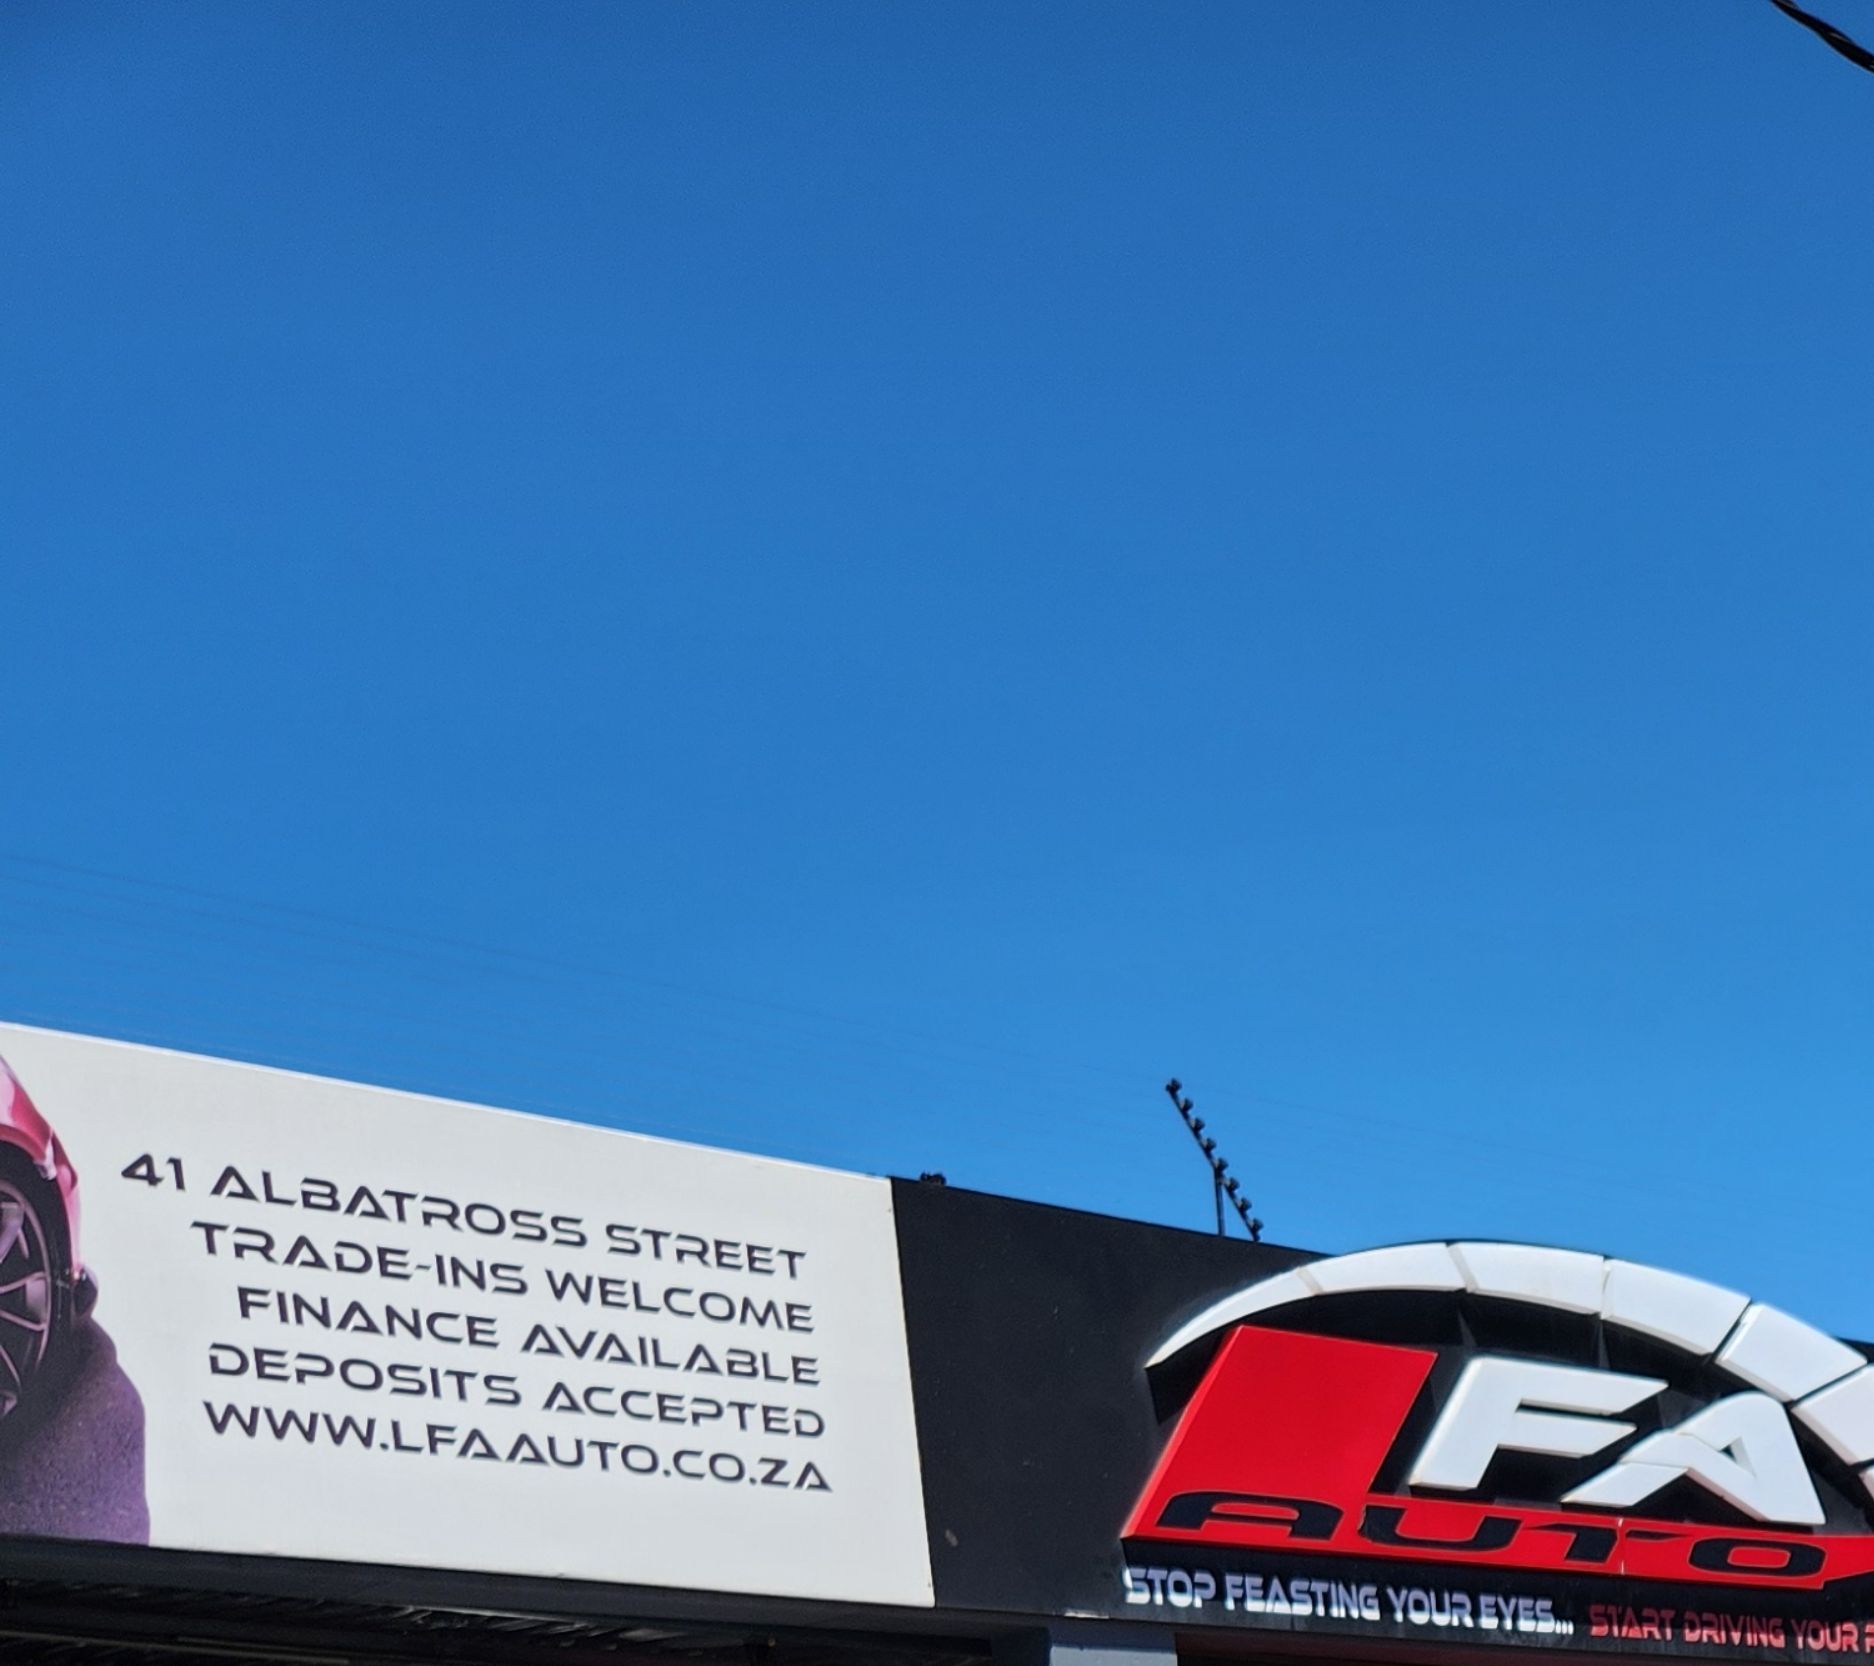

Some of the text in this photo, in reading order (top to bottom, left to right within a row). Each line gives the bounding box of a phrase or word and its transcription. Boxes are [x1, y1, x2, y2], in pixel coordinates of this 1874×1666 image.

[120, 1153, 806, 1280] 41 ALBATROSS STREET
[190, 1220, 814, 1333] TRADE-INS WELCOME
[237, 1286, 820, 1387] FINANCE AVAILABLE
[208, 1342, 826, 1439] DEPOSITS ACCEPTED
[1128, 1325, 1826, 1528] LFA
[203, 1401, 832, 1492] WWW.LFAAUTO.CO.ZA
[1159, 1491, 1826, 1578] AUTO
[1122, 1567, 1574, 1635] STOP FEASTING YOUR EYES...
[1588, 1604, 1676, 1641] START
[1683, 1611, 1786, 1650] DRIVING
[1793, 1617, 1860, 1653] YOUR
